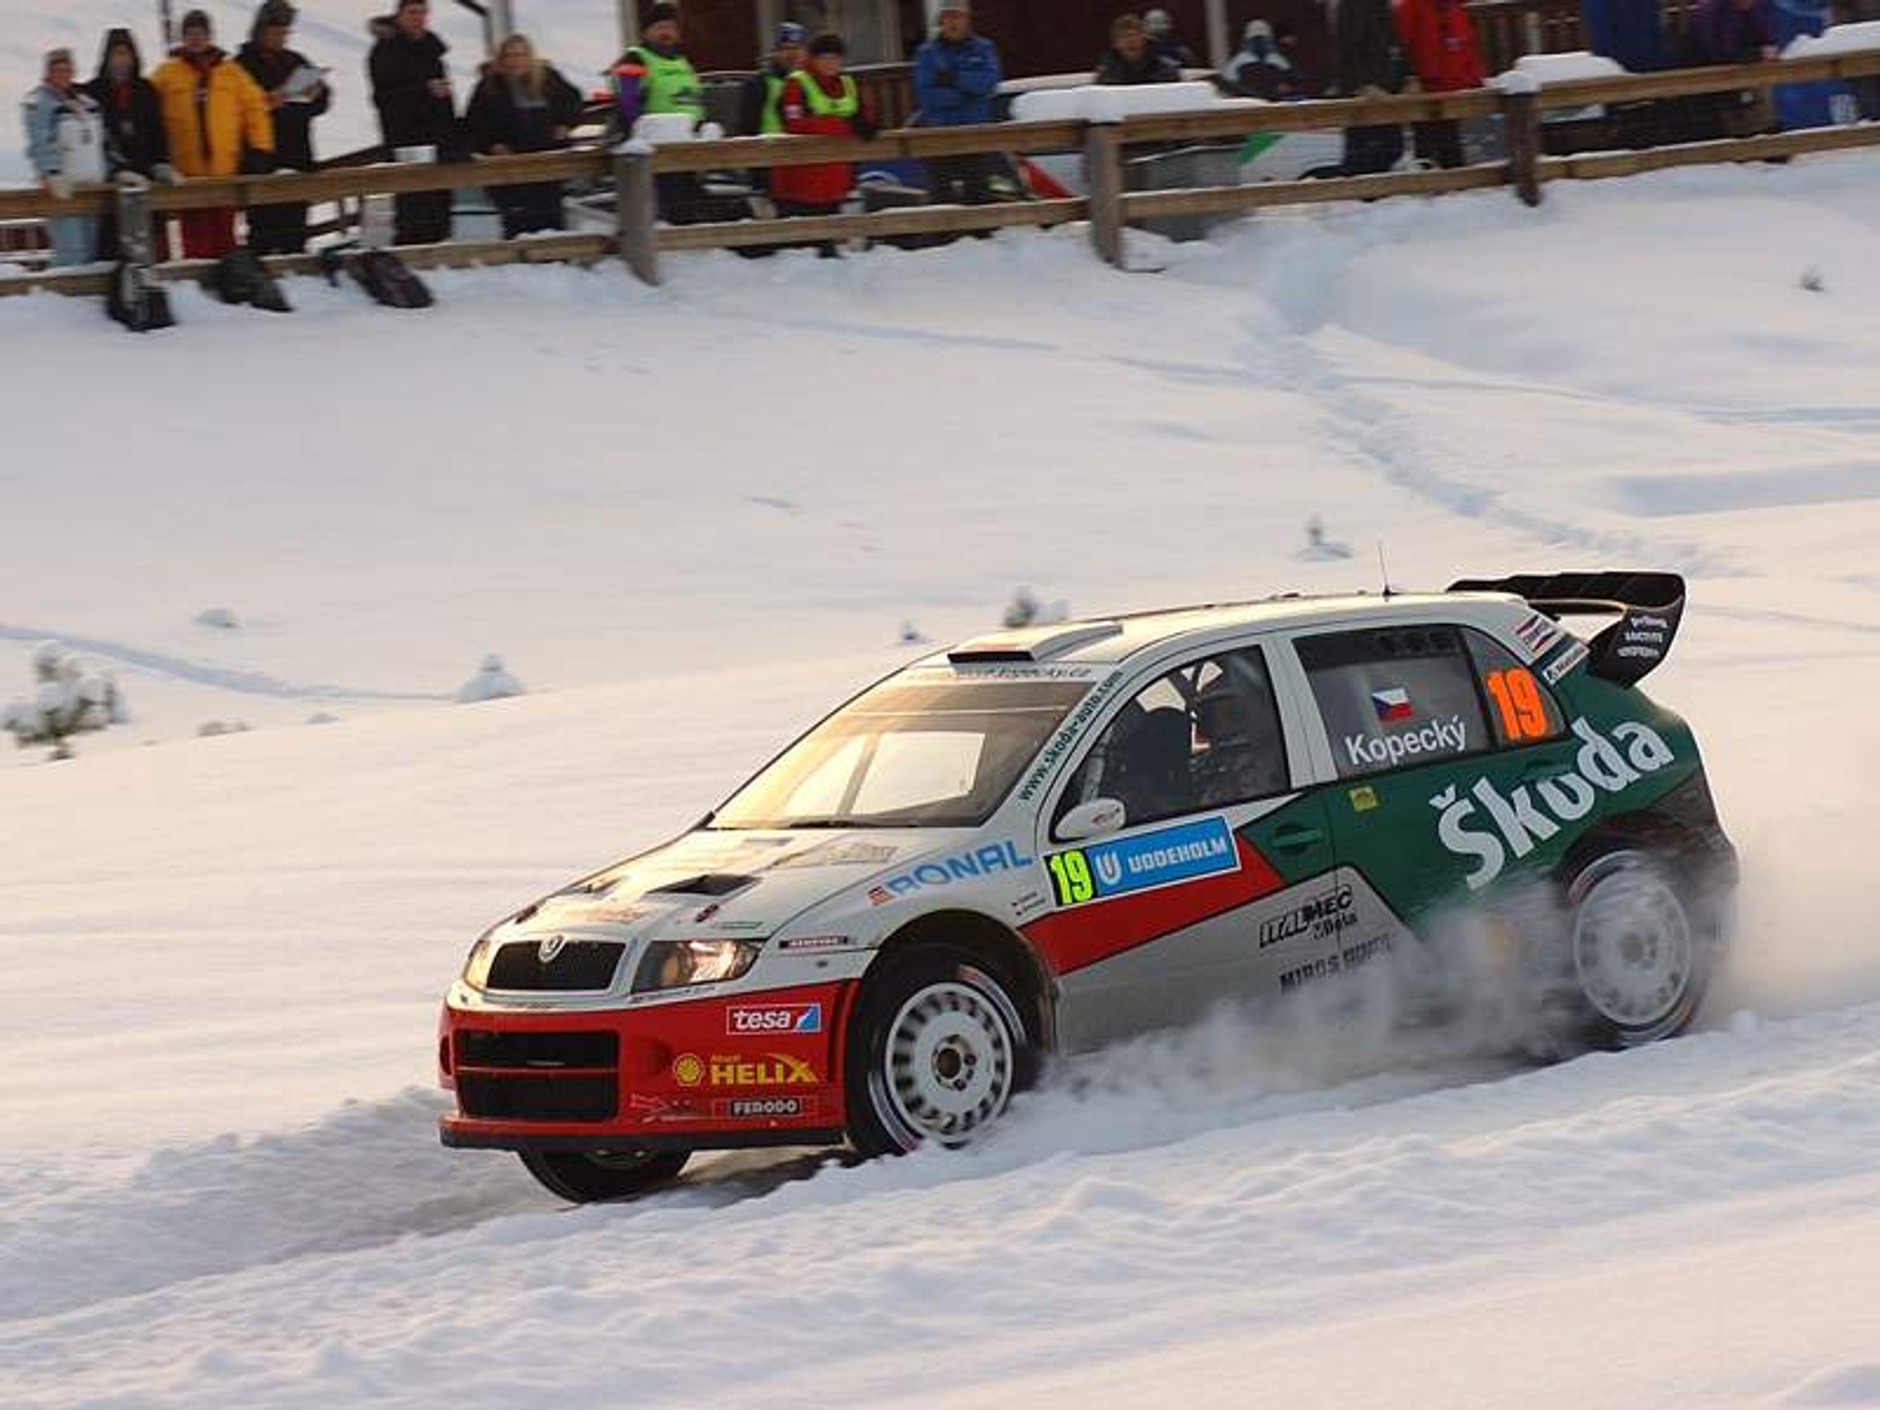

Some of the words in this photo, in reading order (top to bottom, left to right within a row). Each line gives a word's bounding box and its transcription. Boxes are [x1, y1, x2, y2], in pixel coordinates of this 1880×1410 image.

[1487, 667, 1548, 740] 19
[1345, 714, 1466, 765] Kopecký
[1429, 716, 1675, 890] Škoda
[887, 839, 1034, 896] RONAL
[1048, 850, 1093, 904] 19
[1127, 837, 1228, 873] UDDEHOLM
[733, 1009, 791, 1030] tesa
[710, 1053, 819, 1085] HELIX
